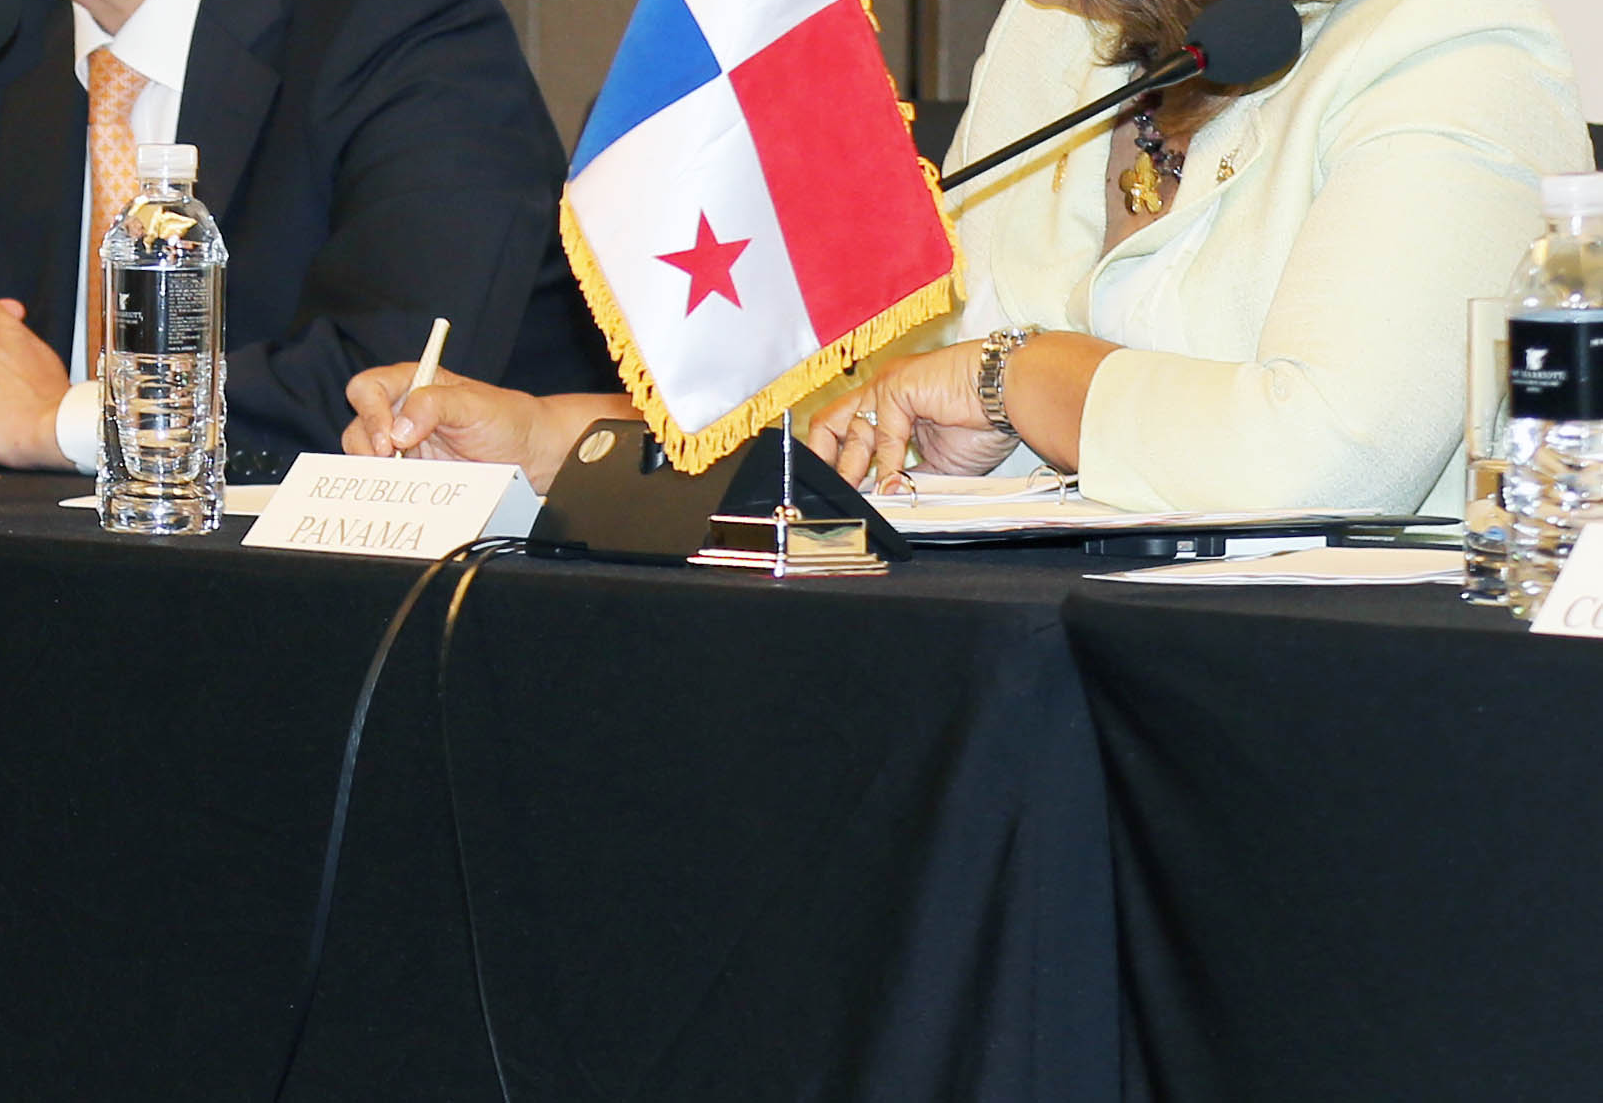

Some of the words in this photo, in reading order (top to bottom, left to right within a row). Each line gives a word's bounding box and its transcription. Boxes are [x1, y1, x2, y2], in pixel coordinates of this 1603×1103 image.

[309, 476, 428, 505] REPUBLIC
[430, 483, 469, 506] OF
[286, 515, 425, 551] PANAMA
